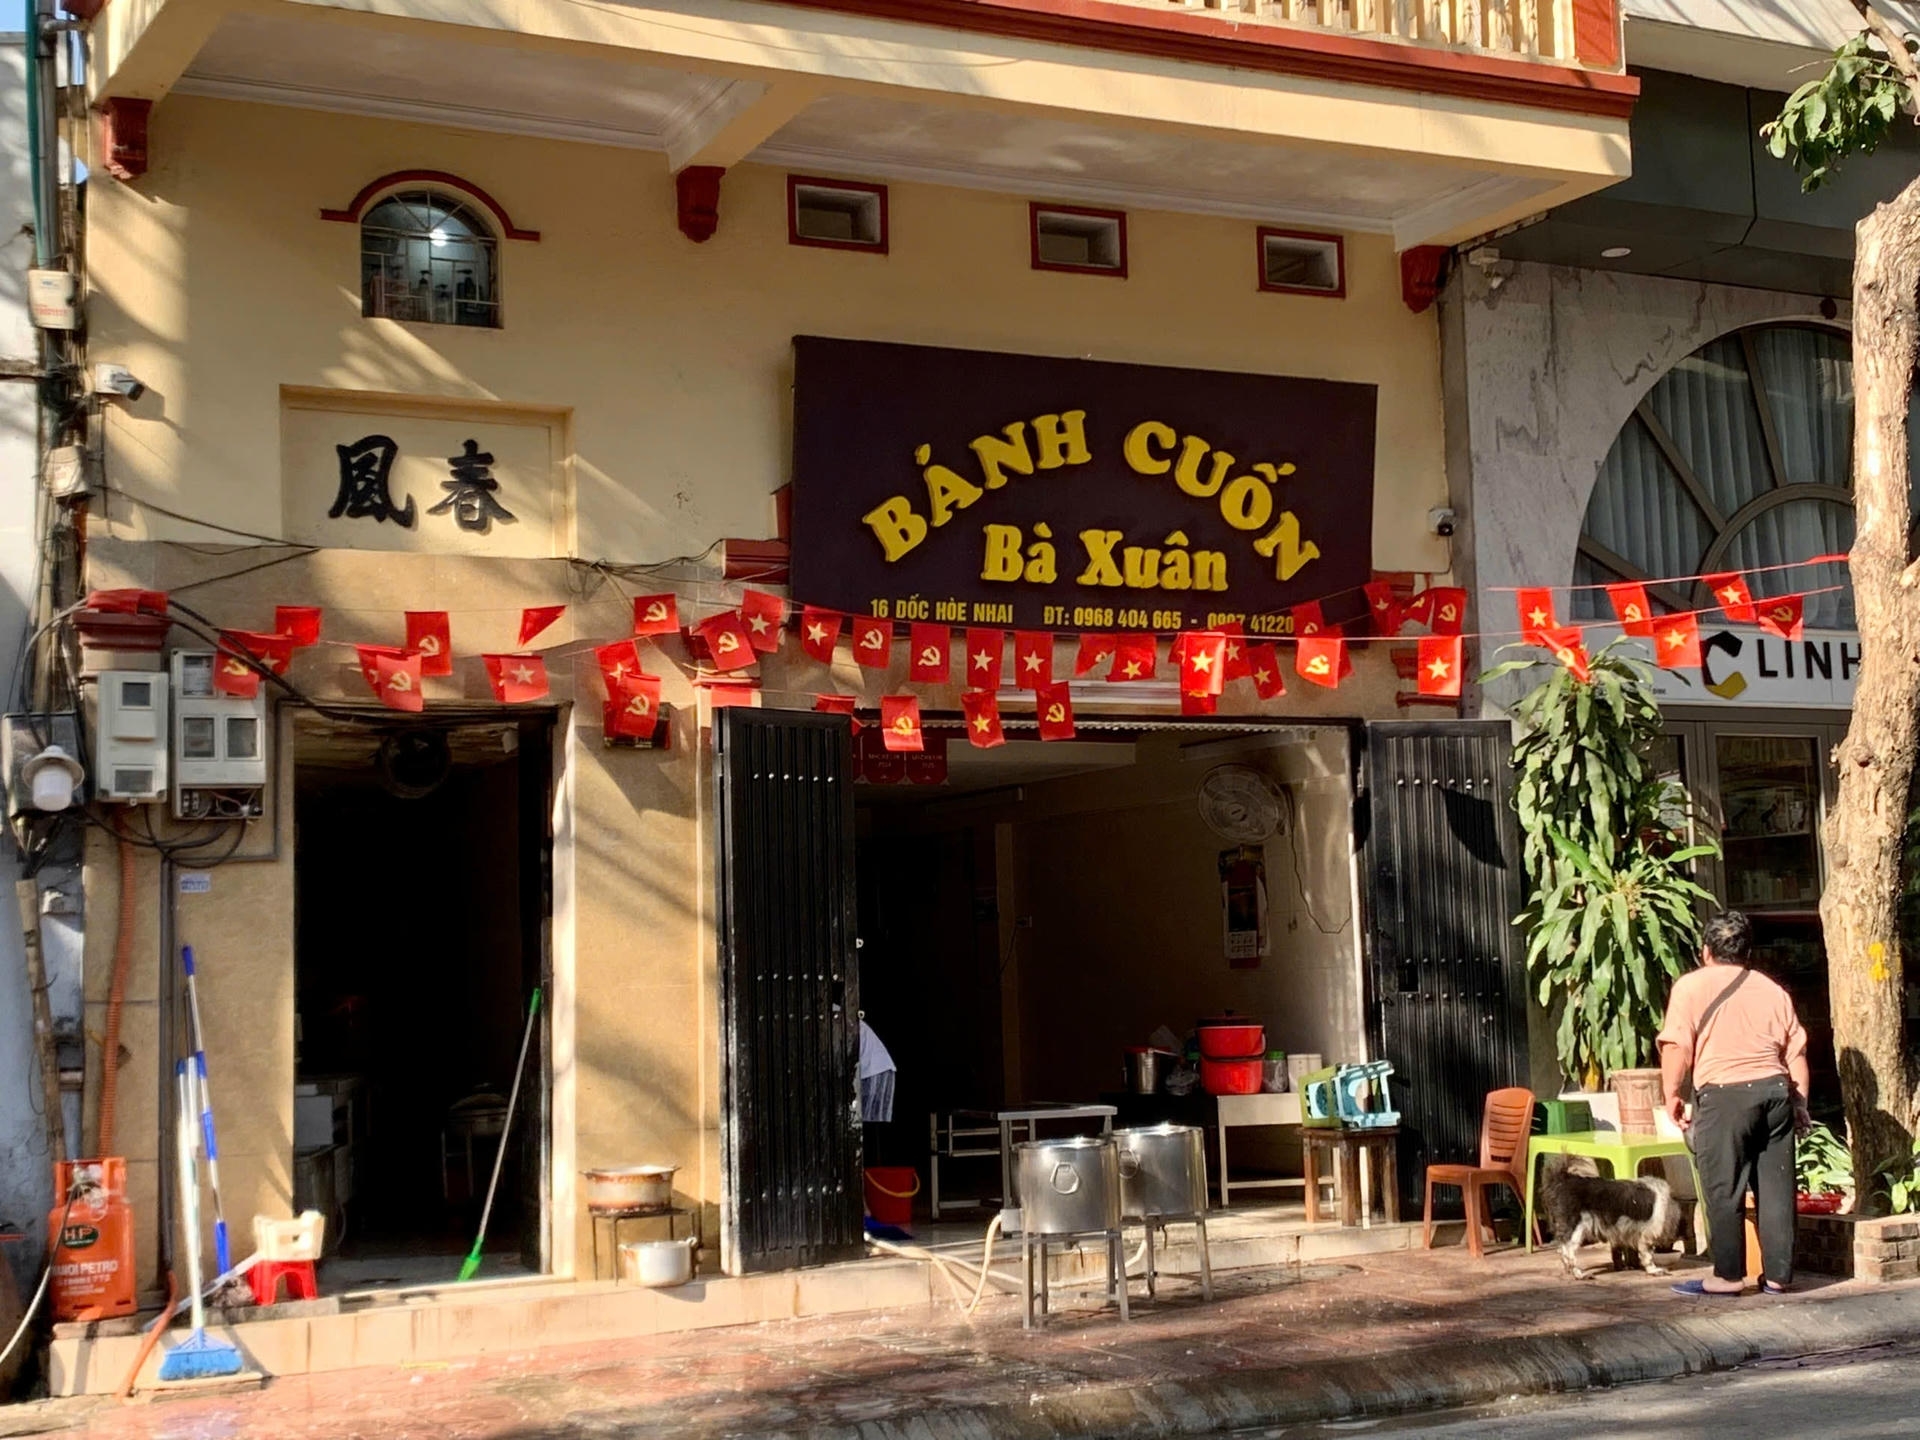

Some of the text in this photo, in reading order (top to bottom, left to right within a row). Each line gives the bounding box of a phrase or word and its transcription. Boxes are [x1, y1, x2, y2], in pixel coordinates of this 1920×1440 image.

[862, 409, 1320, 581] BÁNH CUỐN
[980, 521, 1228, 591] Bà Xuân
[871, 594, 1013, 623] 16 DỐC HÒE NHAI
[1043, 606, 1070, 626] ĐT:
[1073, 606, 1114, 627] 0968
[1118, 608, 1148, 629] 404
[1152, 610, 1182, 630] 665
[1757, 638, 1862, 680] LINH
[80, 1259, 118, 1275] PETRO
